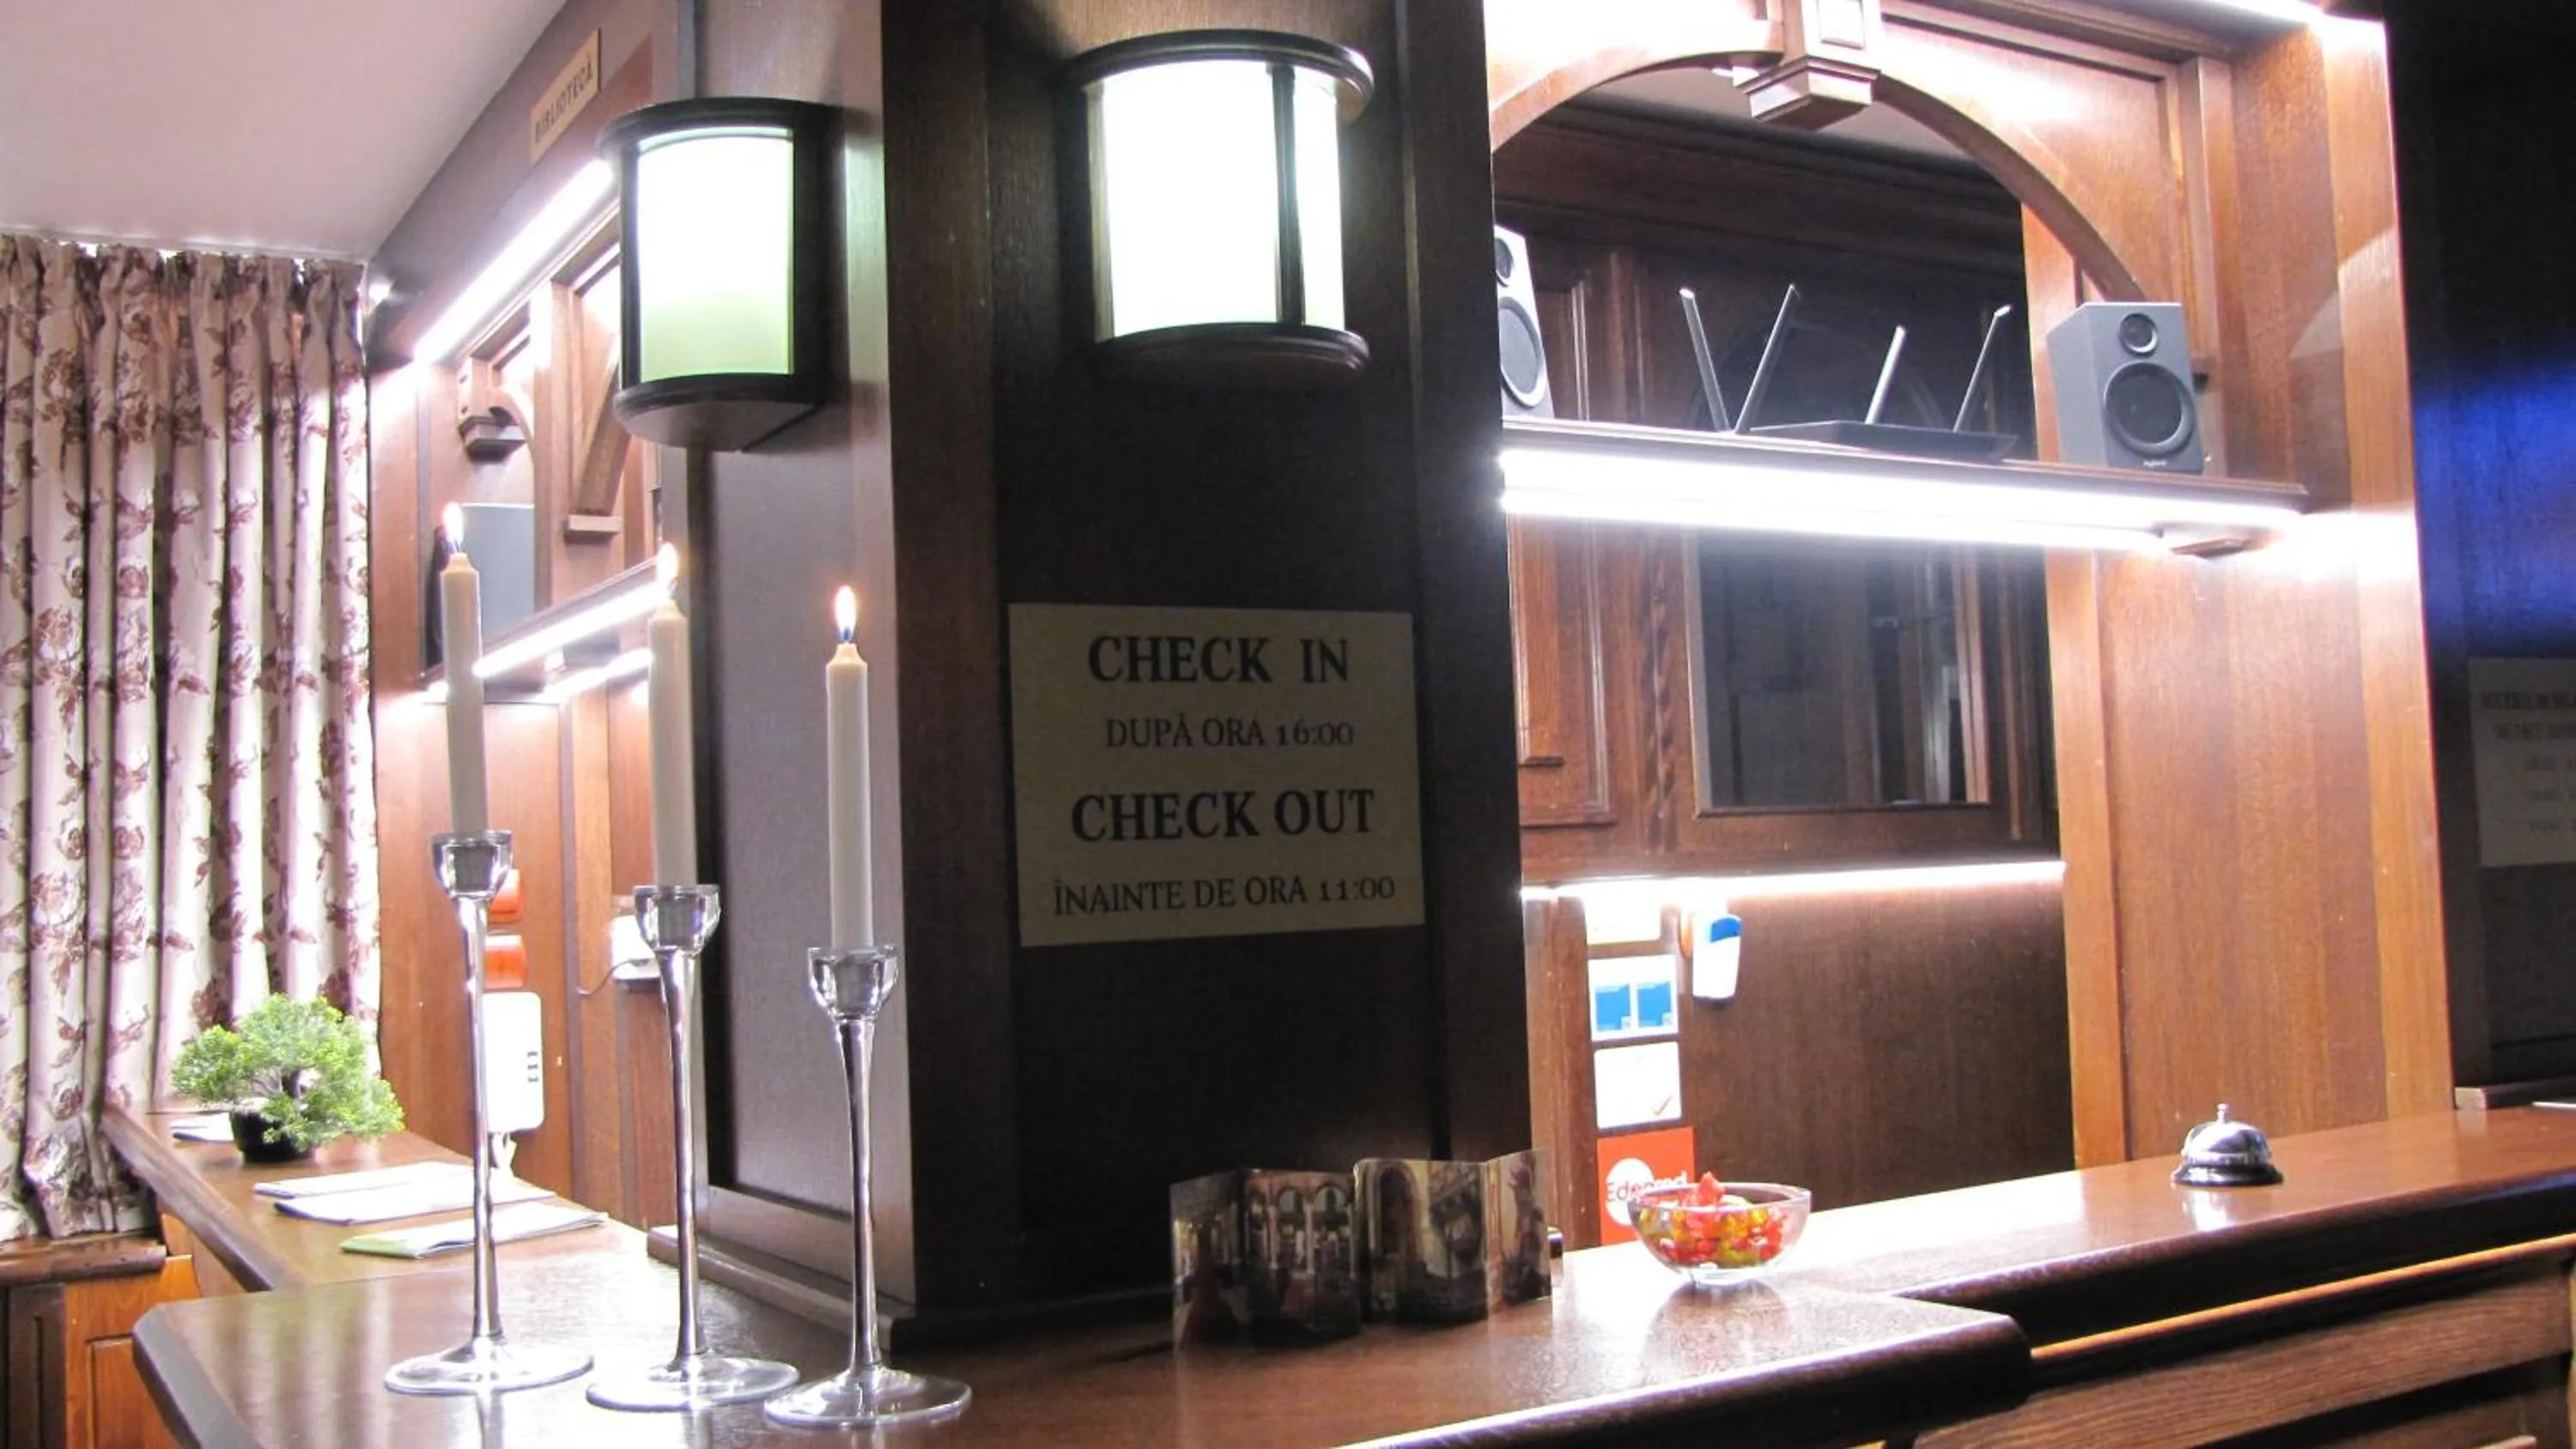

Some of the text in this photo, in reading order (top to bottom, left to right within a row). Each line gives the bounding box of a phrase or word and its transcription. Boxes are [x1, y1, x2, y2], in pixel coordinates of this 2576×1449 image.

[1088, 635, 1349, 683] CHECK IN
[1201, 718, 1265, 747] ORA
[1278, 718, 1354, 747] 16:00
[1072, 788, 1375, 842] CHECK OUT
[1195, 878, 1236, 908] DE
[1244, 876, 1308, 906] ORA
[1320, 876, 1395, 903] 11:00
